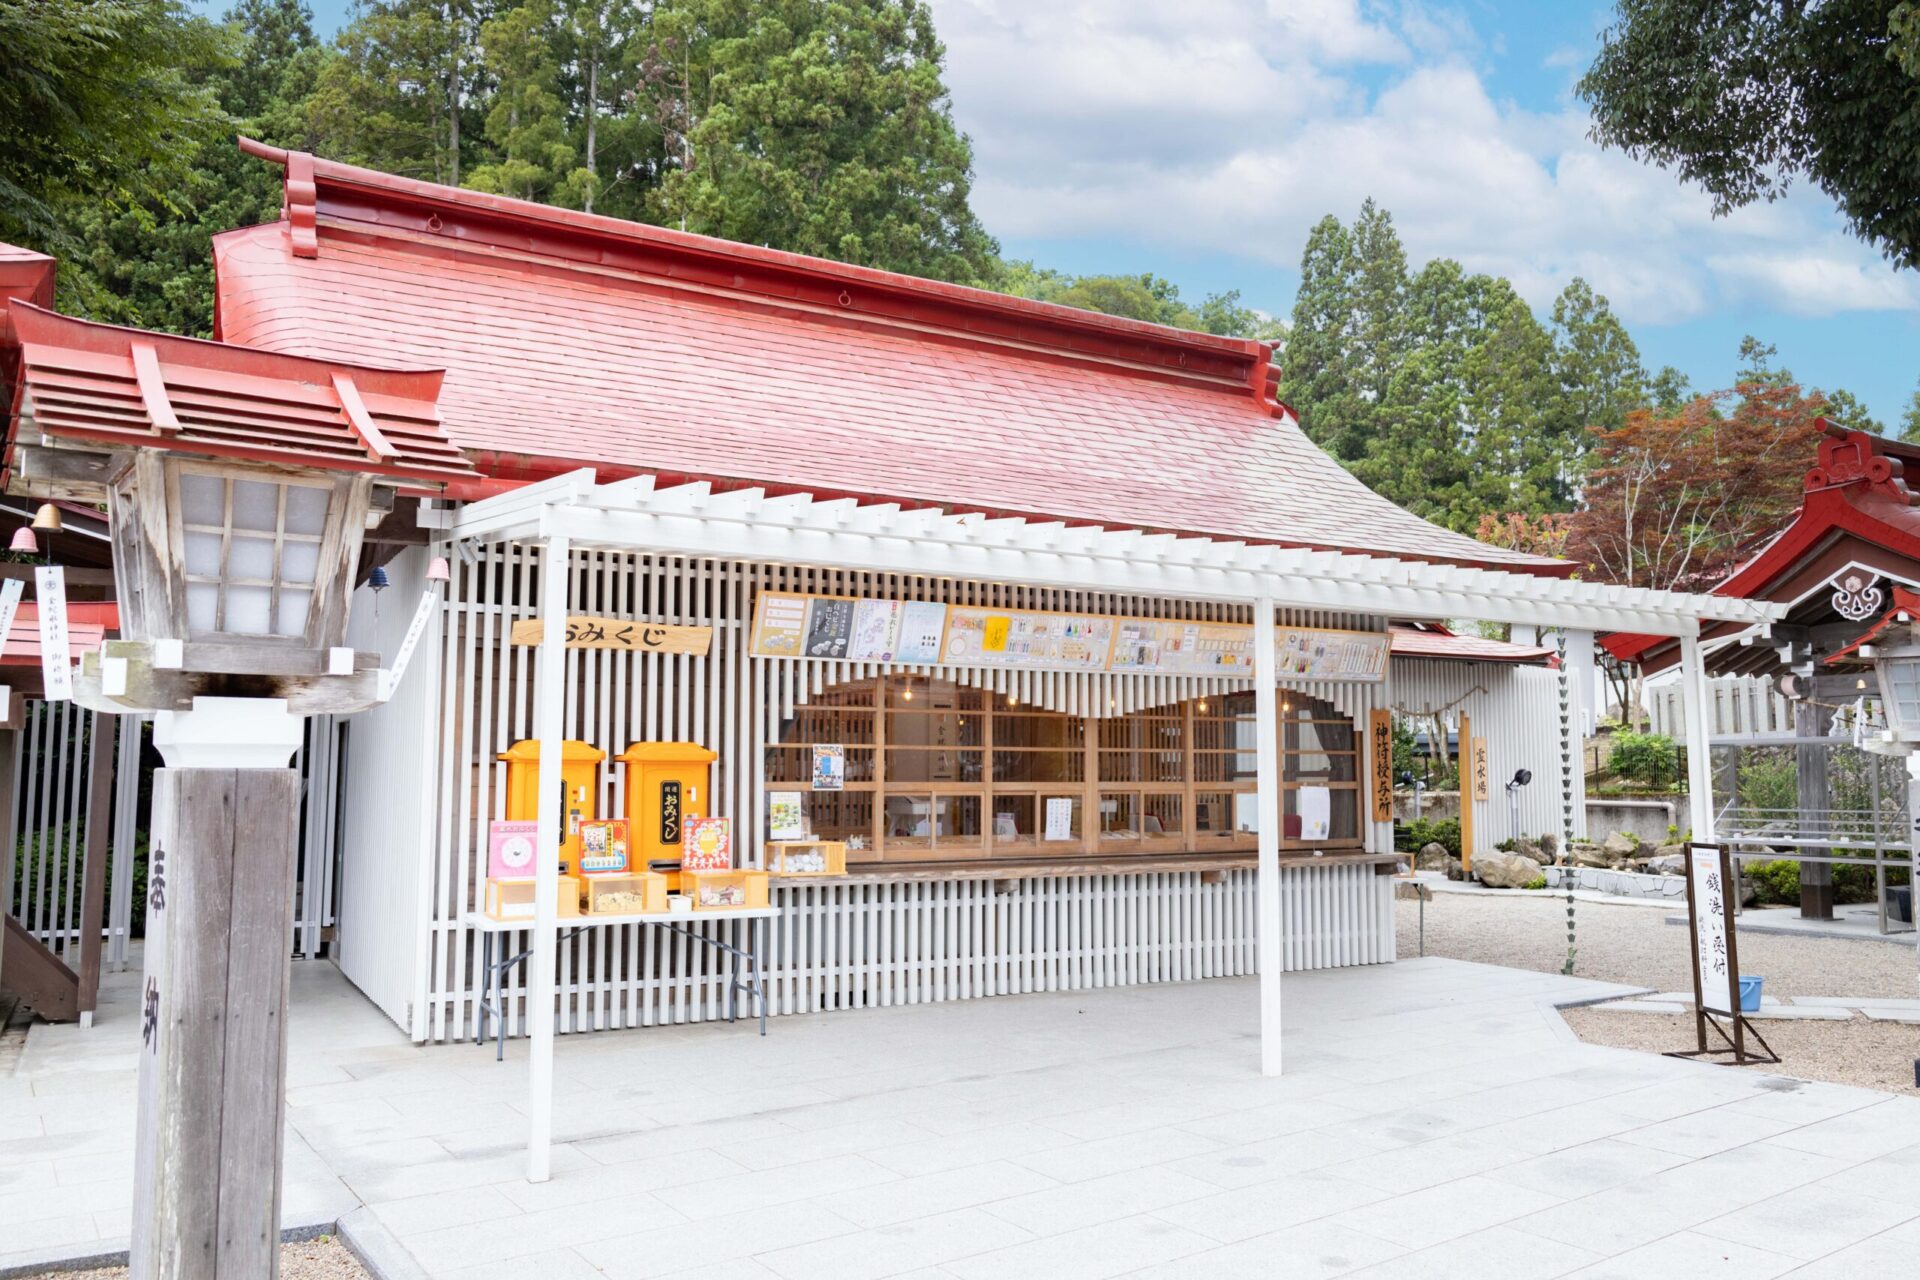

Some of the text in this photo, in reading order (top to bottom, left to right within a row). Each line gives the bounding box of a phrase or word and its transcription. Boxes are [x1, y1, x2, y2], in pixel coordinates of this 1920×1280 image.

[663, 794, 679, 840] おみくじ
[1706, 872, 1726, 976] 銭洗い受付
